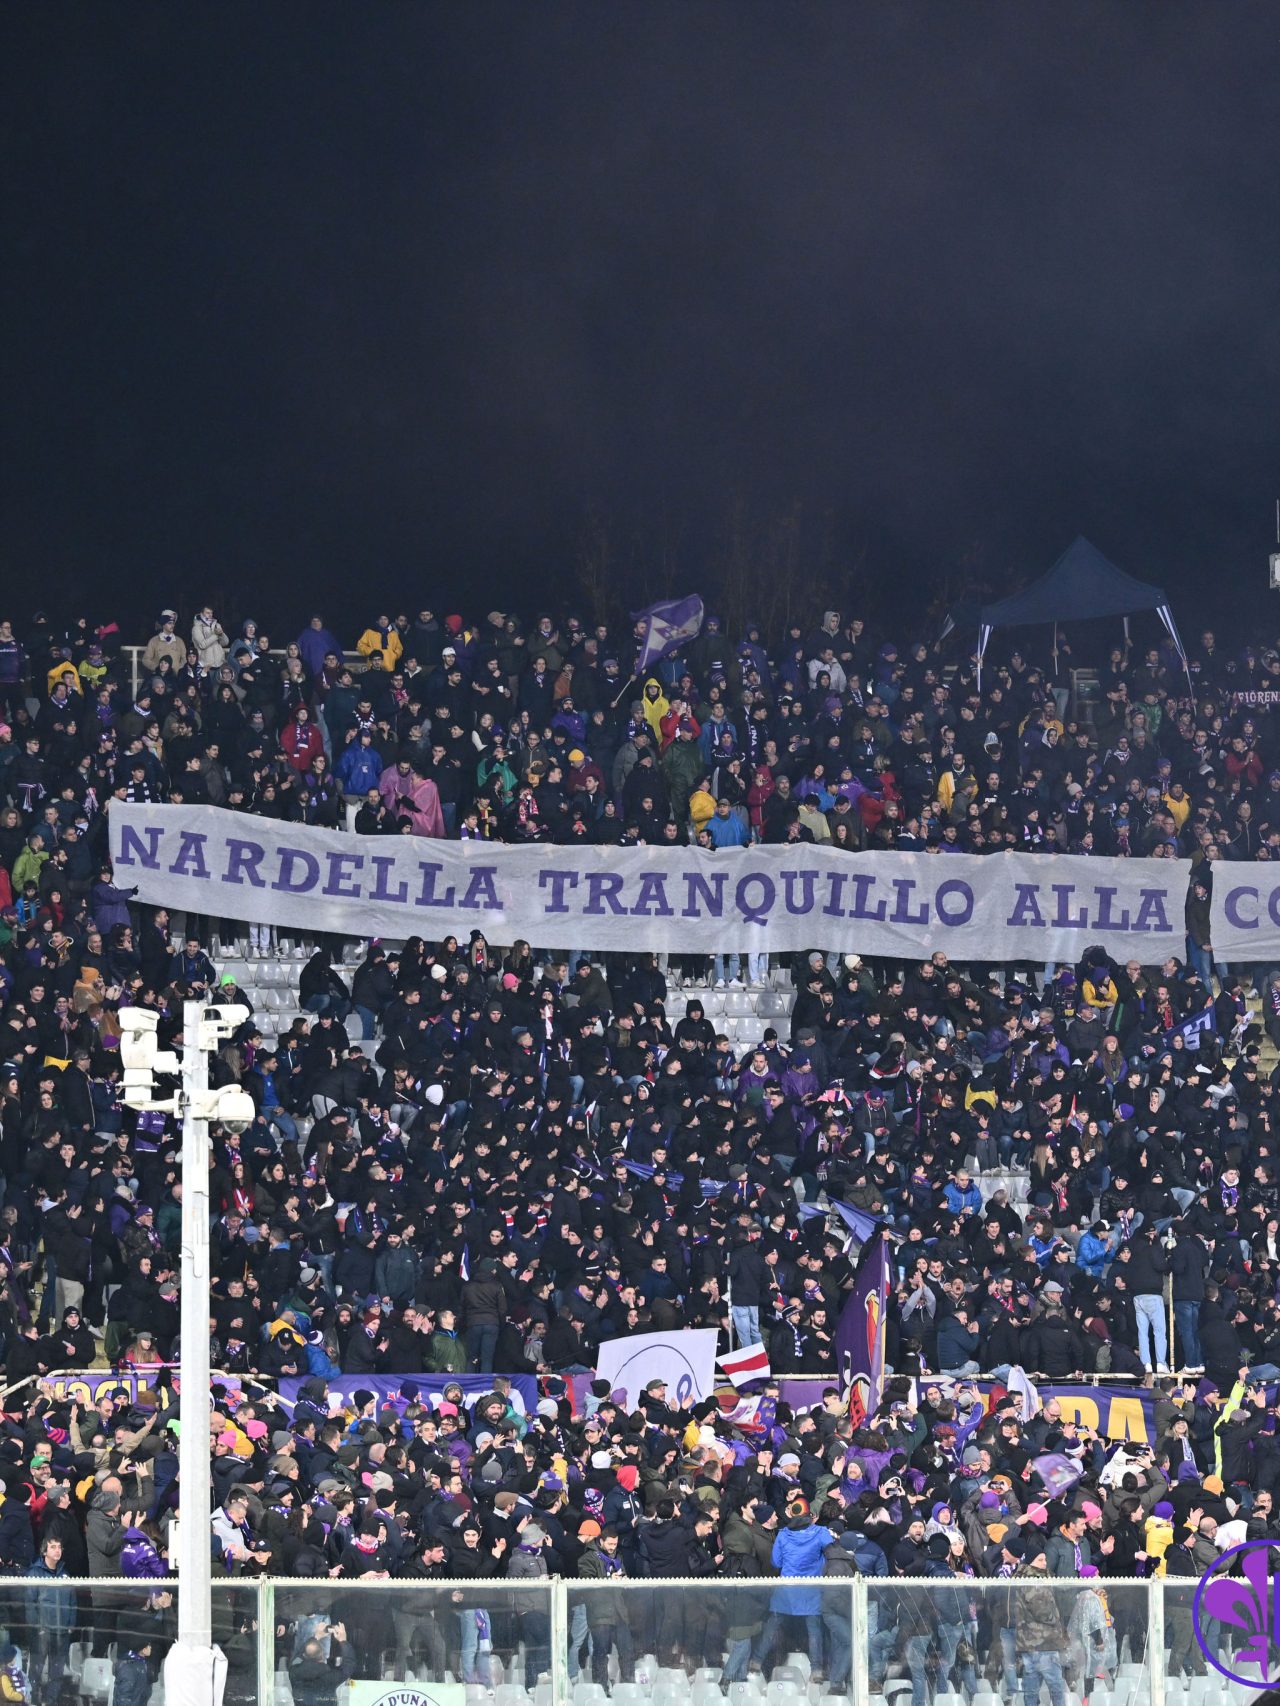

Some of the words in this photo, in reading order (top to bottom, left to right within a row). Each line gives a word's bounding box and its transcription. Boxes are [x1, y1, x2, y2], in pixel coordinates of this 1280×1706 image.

[115, 824, 503, 911] NARDELLA
[538, 869, 974, 927] TRANQUILLO
[1006, 883, 1173, 932] ALLA
